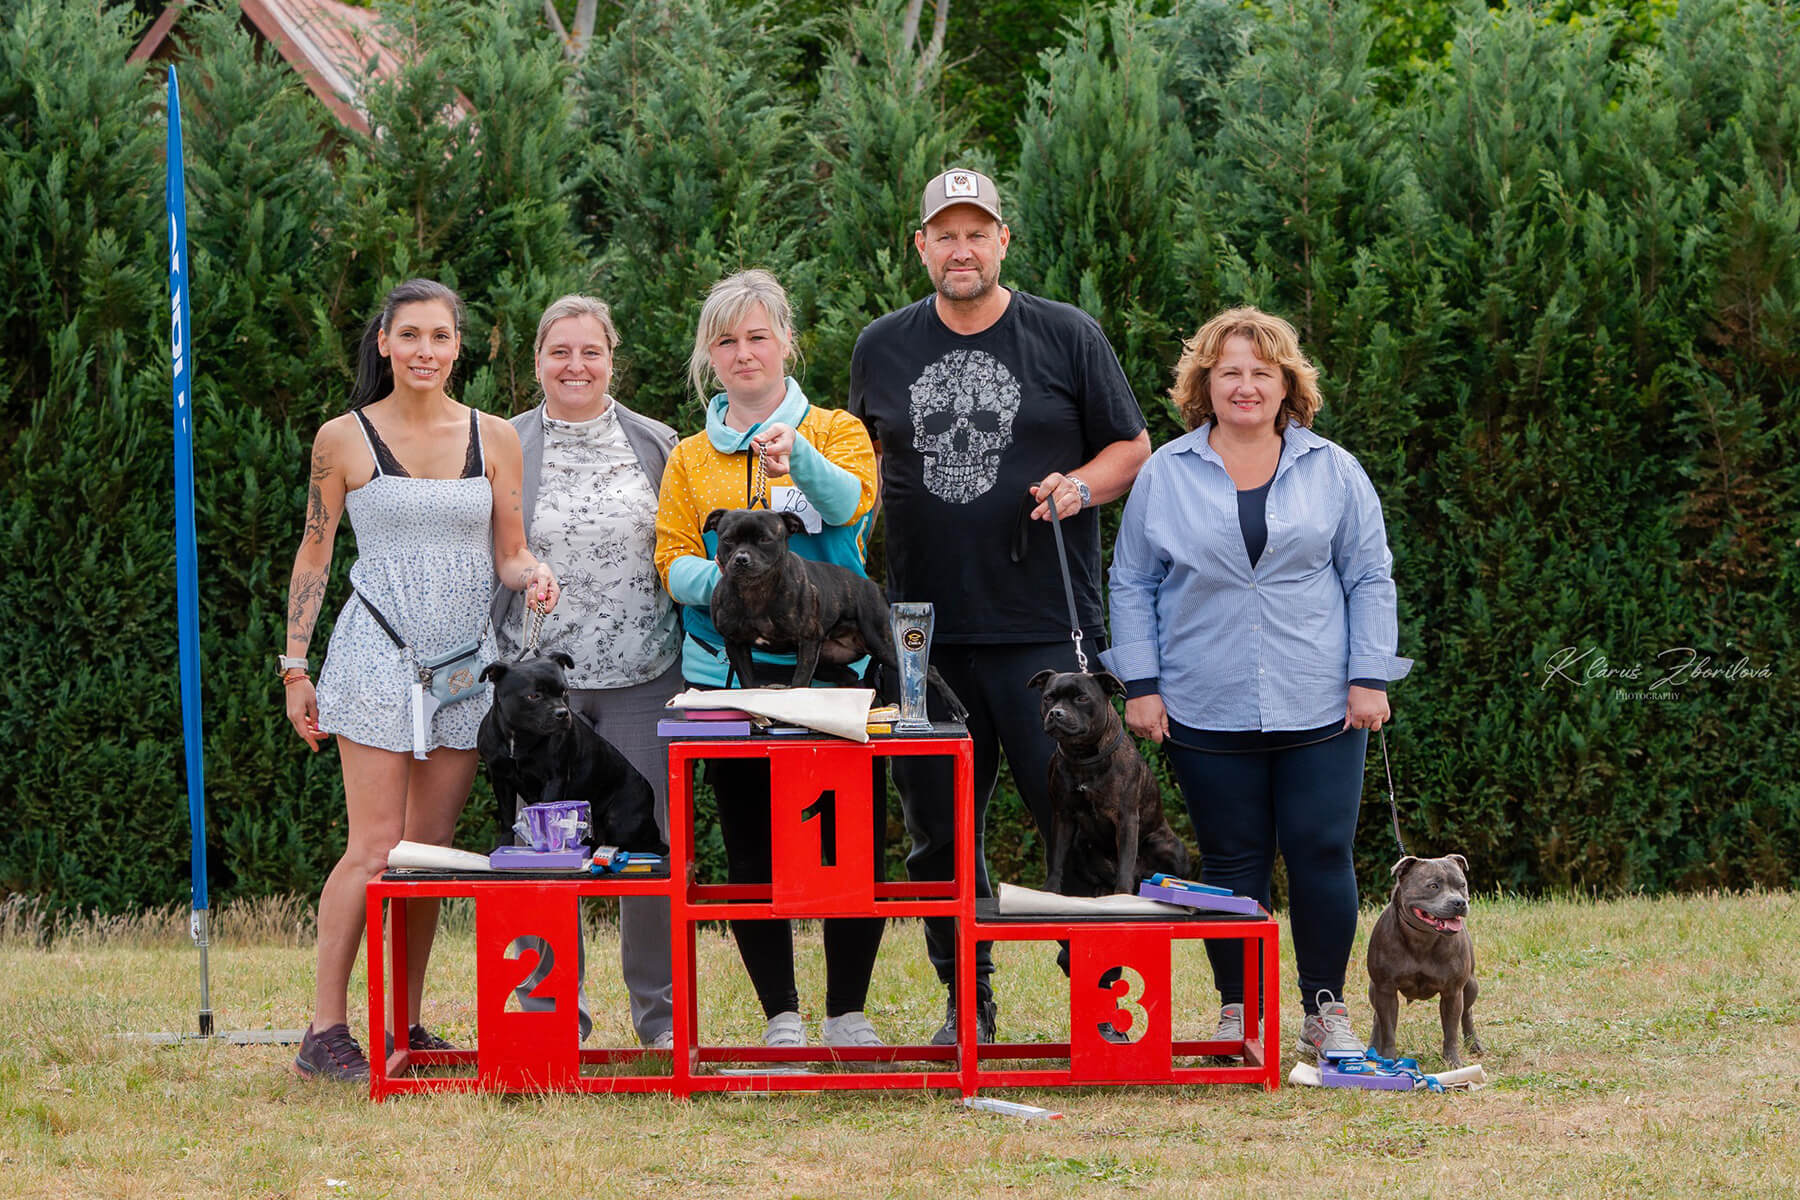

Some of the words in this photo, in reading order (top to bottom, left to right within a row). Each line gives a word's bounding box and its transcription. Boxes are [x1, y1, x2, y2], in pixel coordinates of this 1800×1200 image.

[784, 489, 808, 512] 26
[801, 790, 837, 867] 1
[503, 935, 556, 1013] 2
[1097, 966, 1149, 1044] 3
